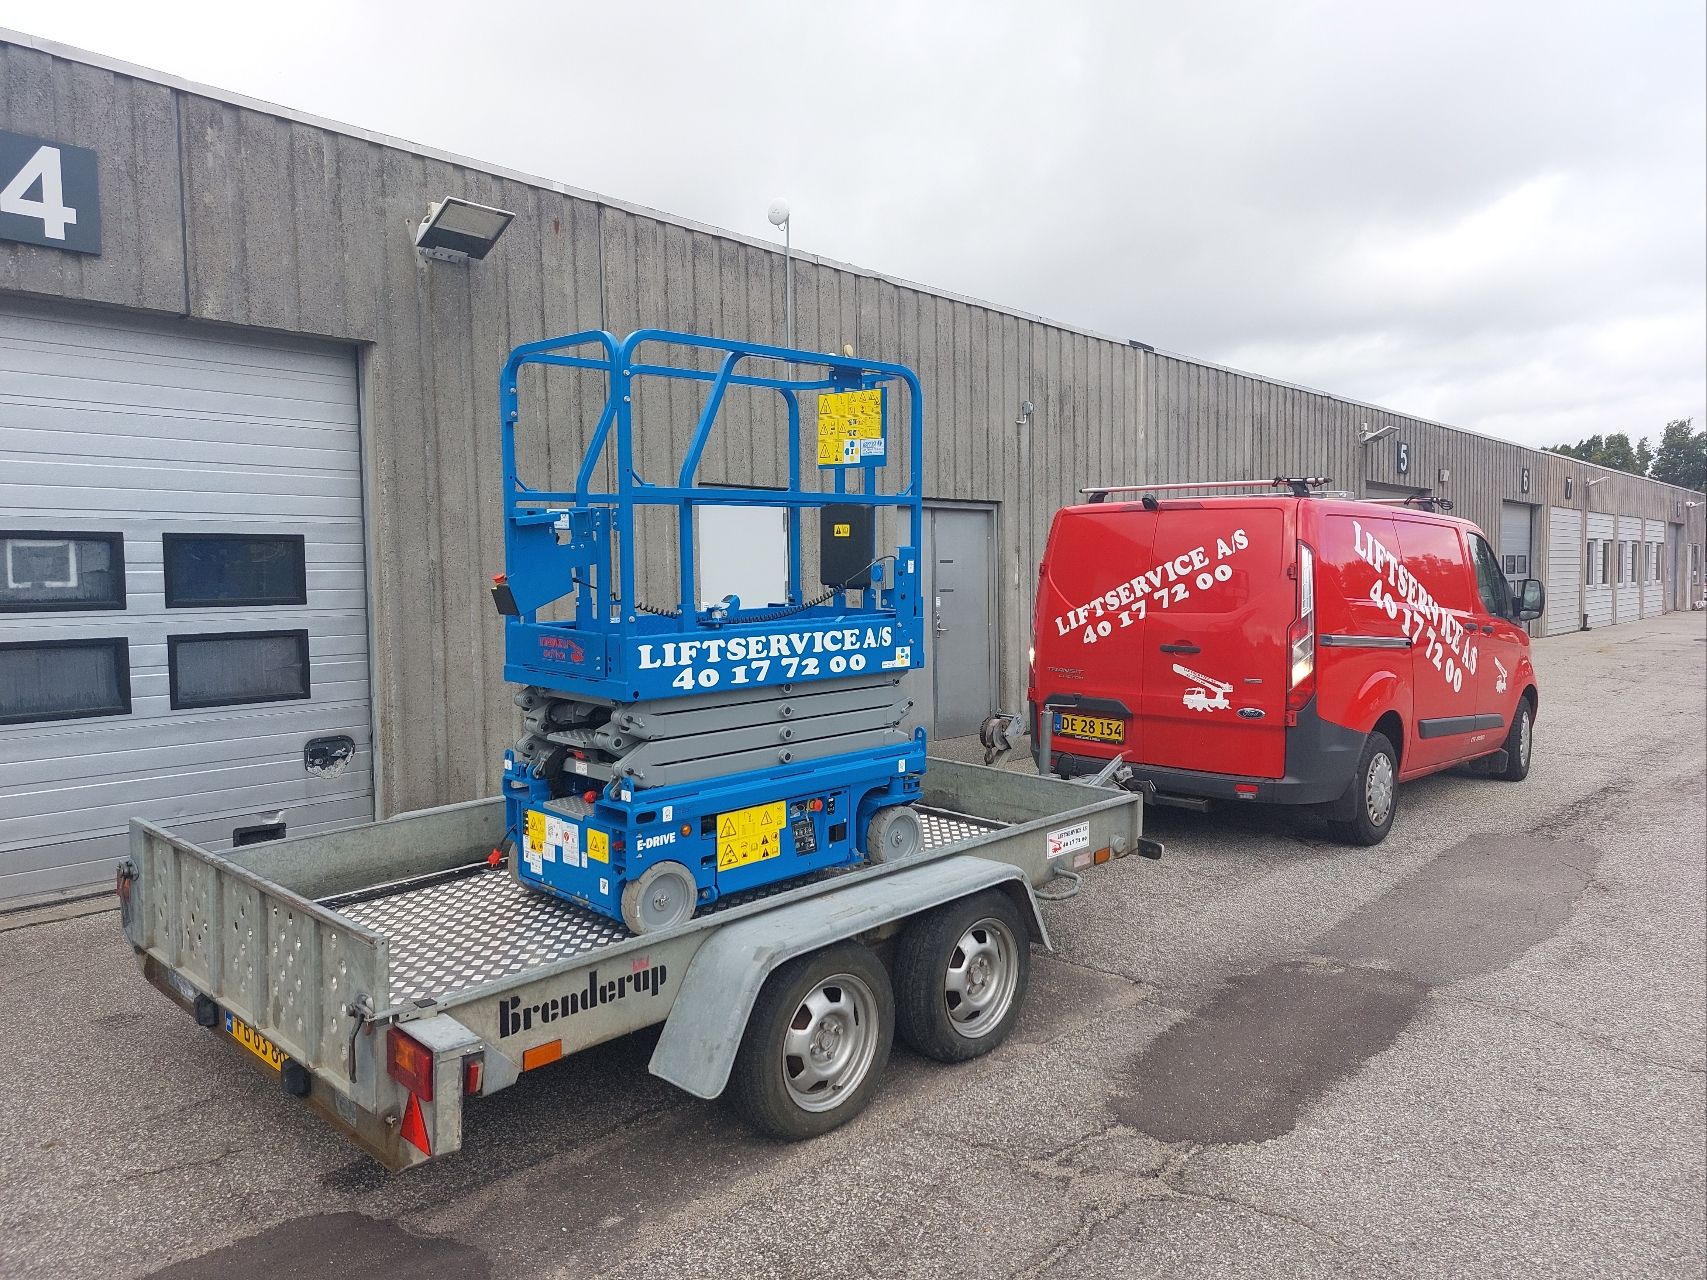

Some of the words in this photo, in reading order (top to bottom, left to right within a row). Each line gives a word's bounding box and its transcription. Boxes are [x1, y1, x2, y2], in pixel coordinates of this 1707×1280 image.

[0, 145, 77, 240] 4
[1400, 444, 1408, 471] 5
[1523, 470, 1529, 491] 6
[1567, 478, 1572, 498] 7
[1055, 546, 1209, 636] LIFTSERVICE
[1216, 528, 1249, 559] A/S
[1353, 520, 1464, 656] LIFTSERVICE
[1083, 620, 1112, 644] 40
[1117, 600, 1147, 628] 17
[1153, 583, 1190, 609] 72
[1195, 564, 1233, 590] 00
[637, 628, 861, 669] LIFTSERVICE
[863, 626, 892, 648] A/S
[1369, 579, 1397, 619] 40
[1401, 608, 1425, 644] 17
[1425, 627, 1443, 671] 72
[1445, 658, 1462, 692] 00
[672, 667, 720, 689] 40
[730, 659, 770, 684] 17
[781, 656, 820, 678] 72
[829, 653, 866, 673] 00
[1062, 717, 1078, 732] DE
[1080, 719, 1096, 734] 28
[1100, 721, 1122, 737] 154
[637, 832, 676, 851] E-DRIVE
[499, 964, 667, 1039] Brenderup
[237, 1017, 251, 1042] FB
